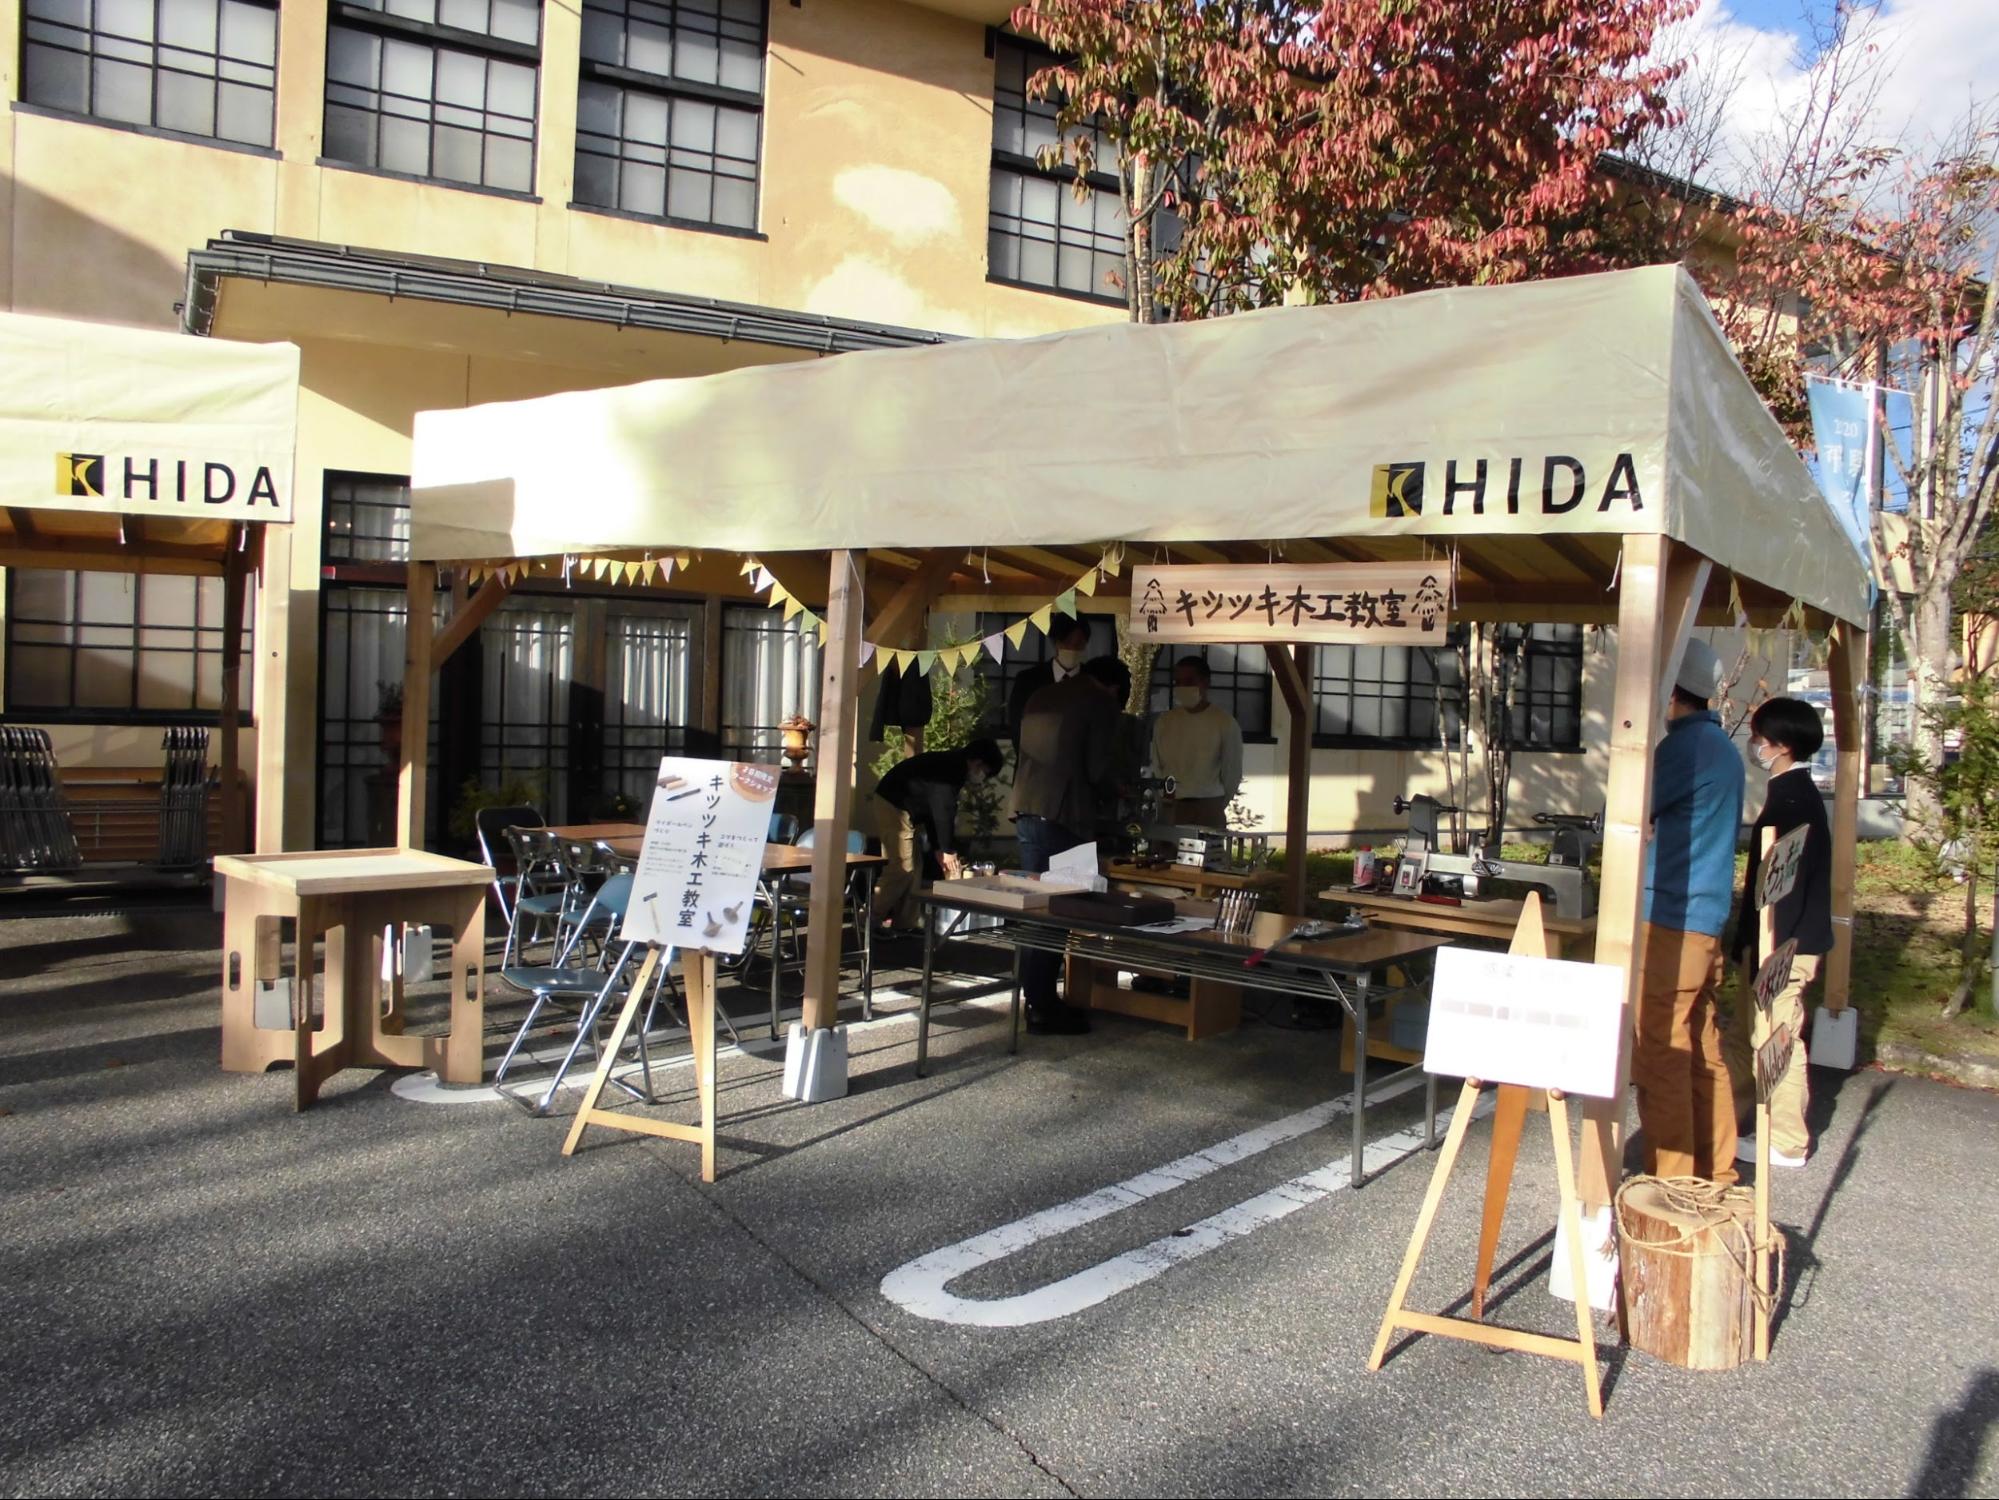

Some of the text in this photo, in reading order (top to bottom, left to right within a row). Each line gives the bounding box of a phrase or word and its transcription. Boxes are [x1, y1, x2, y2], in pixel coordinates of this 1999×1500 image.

[123, 456, 280, 508] HIDA
[1442, 453, 1644, 515] HIDA
[1175, 584, 1407, 629] キツツキ木工教室
[677, 774, 725, 927] キツツキ木工教室
